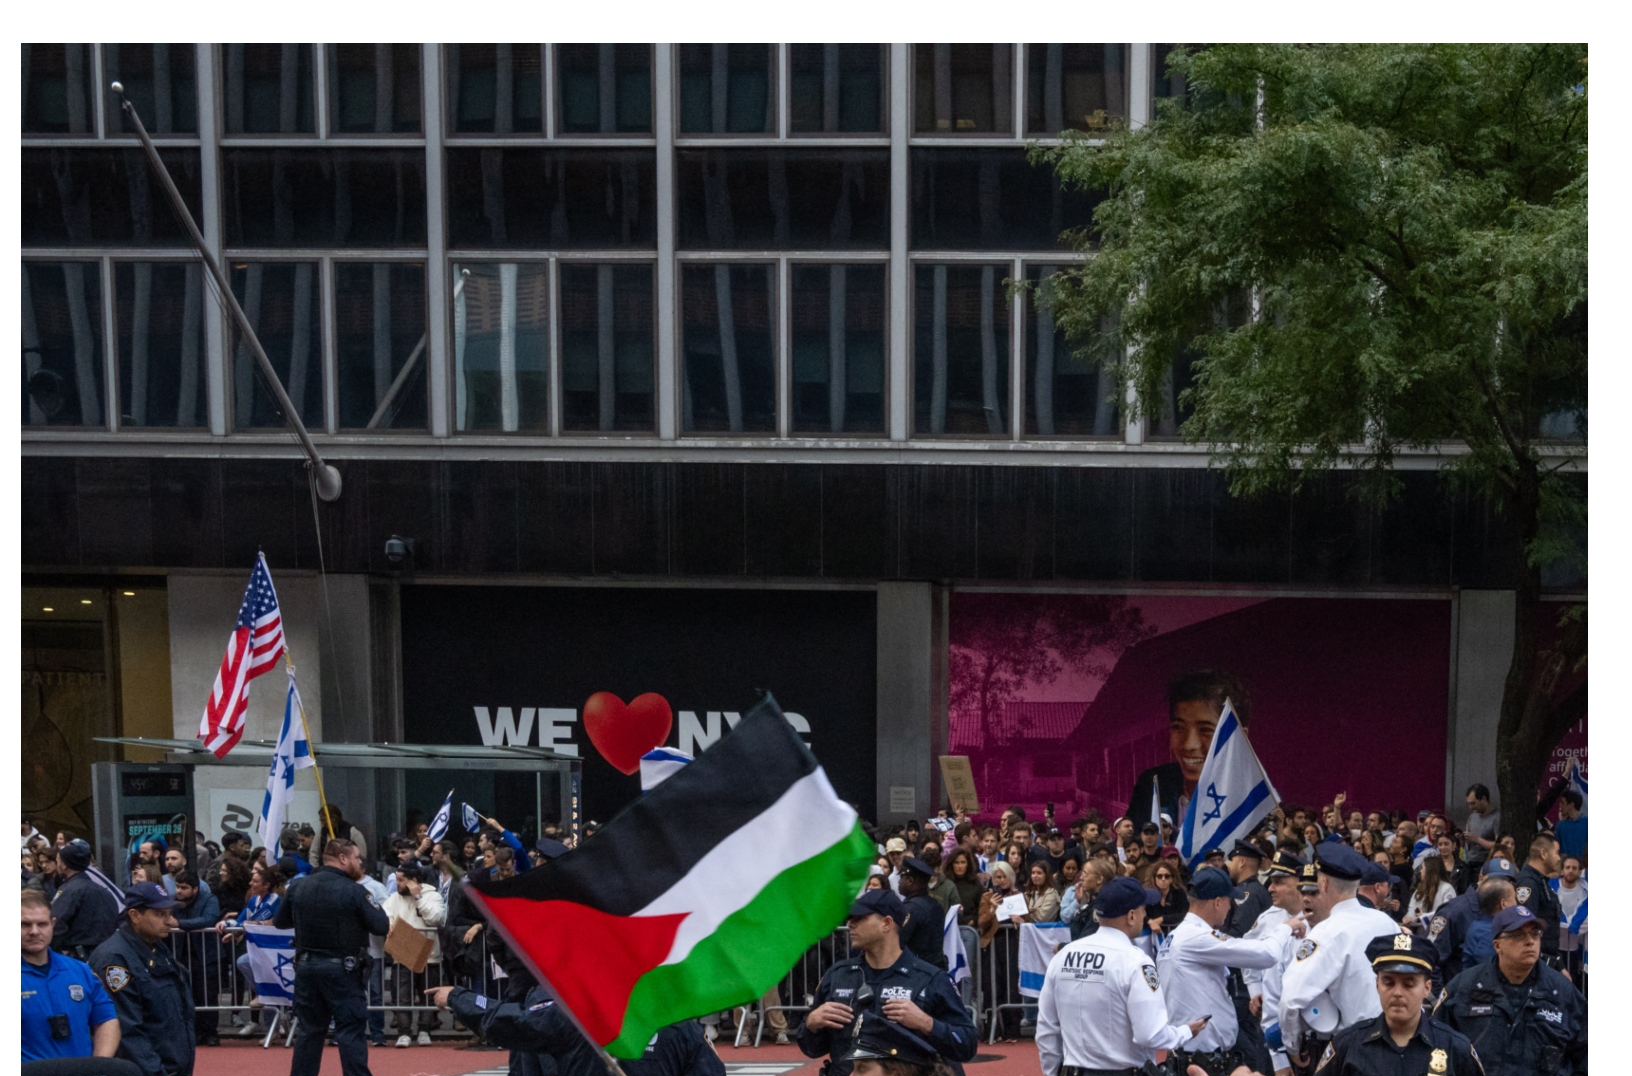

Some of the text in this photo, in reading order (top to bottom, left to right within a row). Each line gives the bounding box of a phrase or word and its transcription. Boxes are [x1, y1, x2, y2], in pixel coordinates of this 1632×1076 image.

[473, 706, 578, 757] WE
[128, 823, 172, 836] SEPTEMBER
[1064, 951, 1106, 969] NYPD
[881, 987, 912, 997] POLICE
